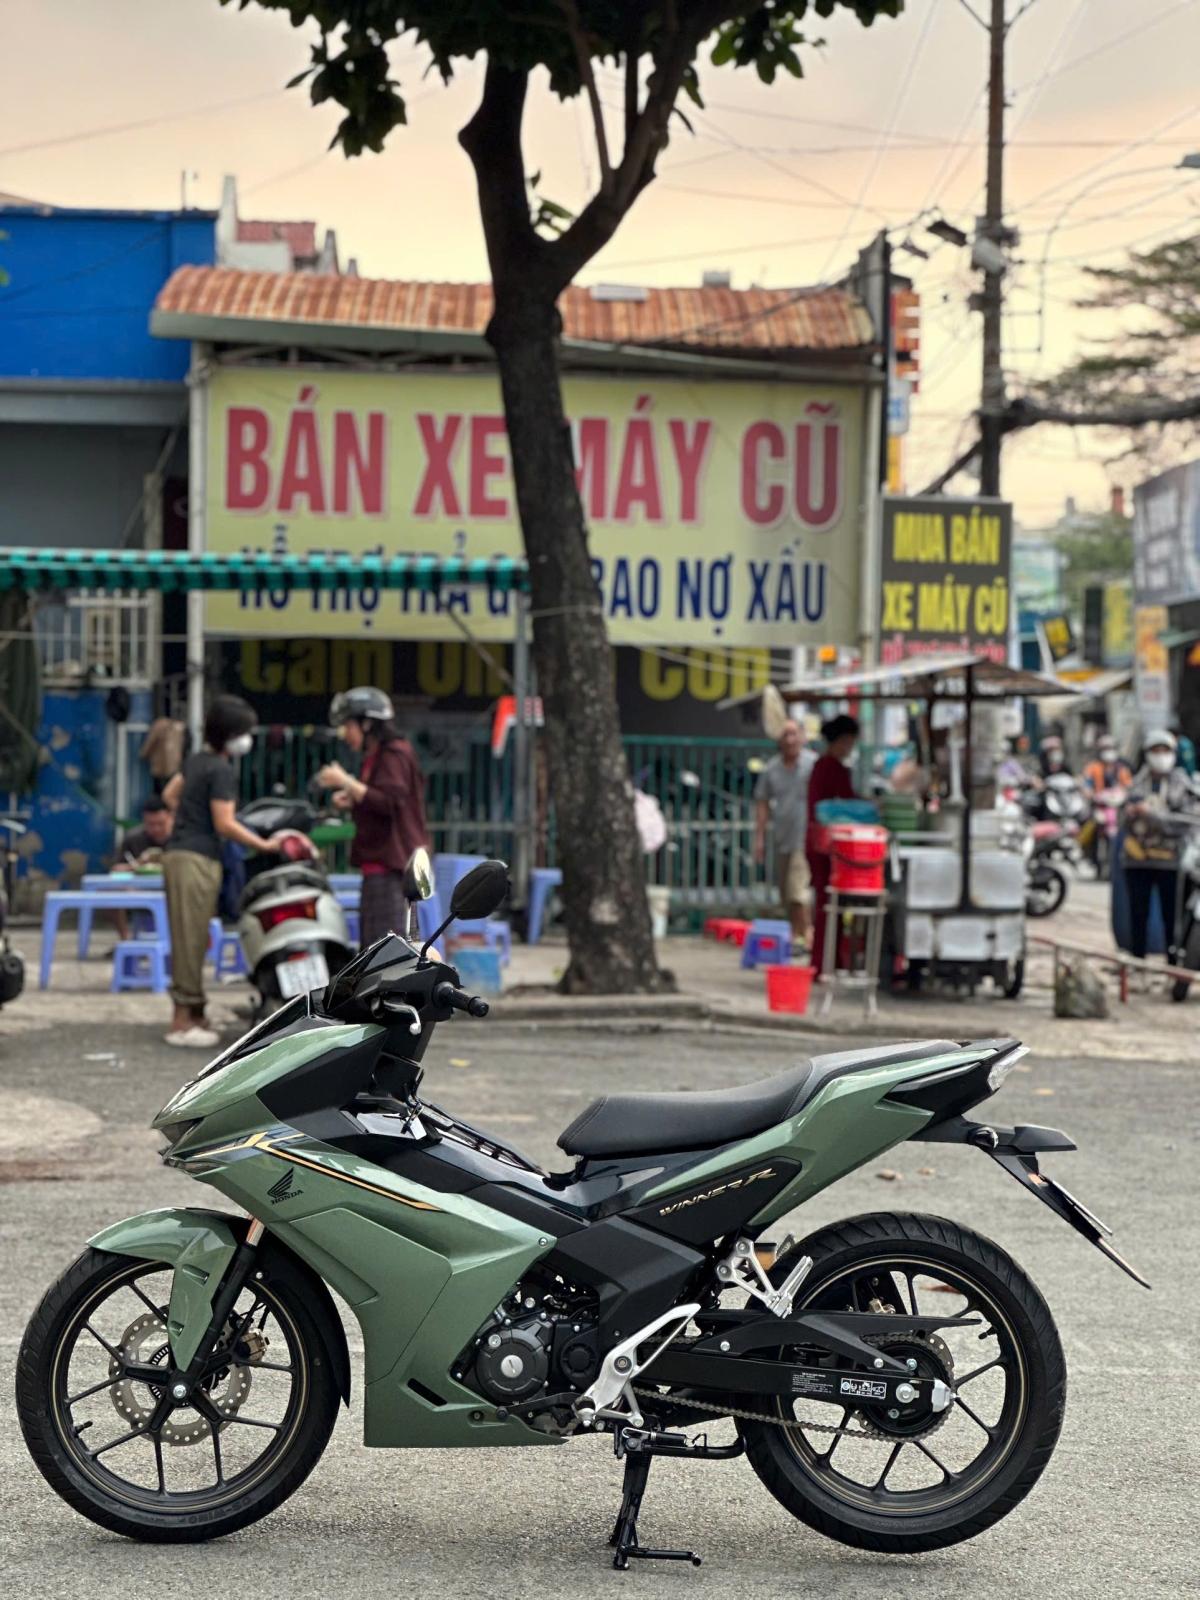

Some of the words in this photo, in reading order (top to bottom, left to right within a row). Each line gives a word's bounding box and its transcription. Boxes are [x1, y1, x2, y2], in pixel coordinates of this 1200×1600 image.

[225, 385, 383, 514] BÁN
[413, 413, 508, 516] XE
[741, 402, 839, 525] CŨ
[893, 512, 946, 563] MUA
[951, 505, 1000, 565] BÁN
[677, 554, 733, 635] NỢ
[747, 537, 825, 622] XẤU
[882, 582, 913, 631] XE
[918, 573, 971, 633] MÁY
[974, 576, 1008, 635] CŨ
[270, 1189, 304, 1205] HONDA
[659, 1179, 743, 1216] WINNER
